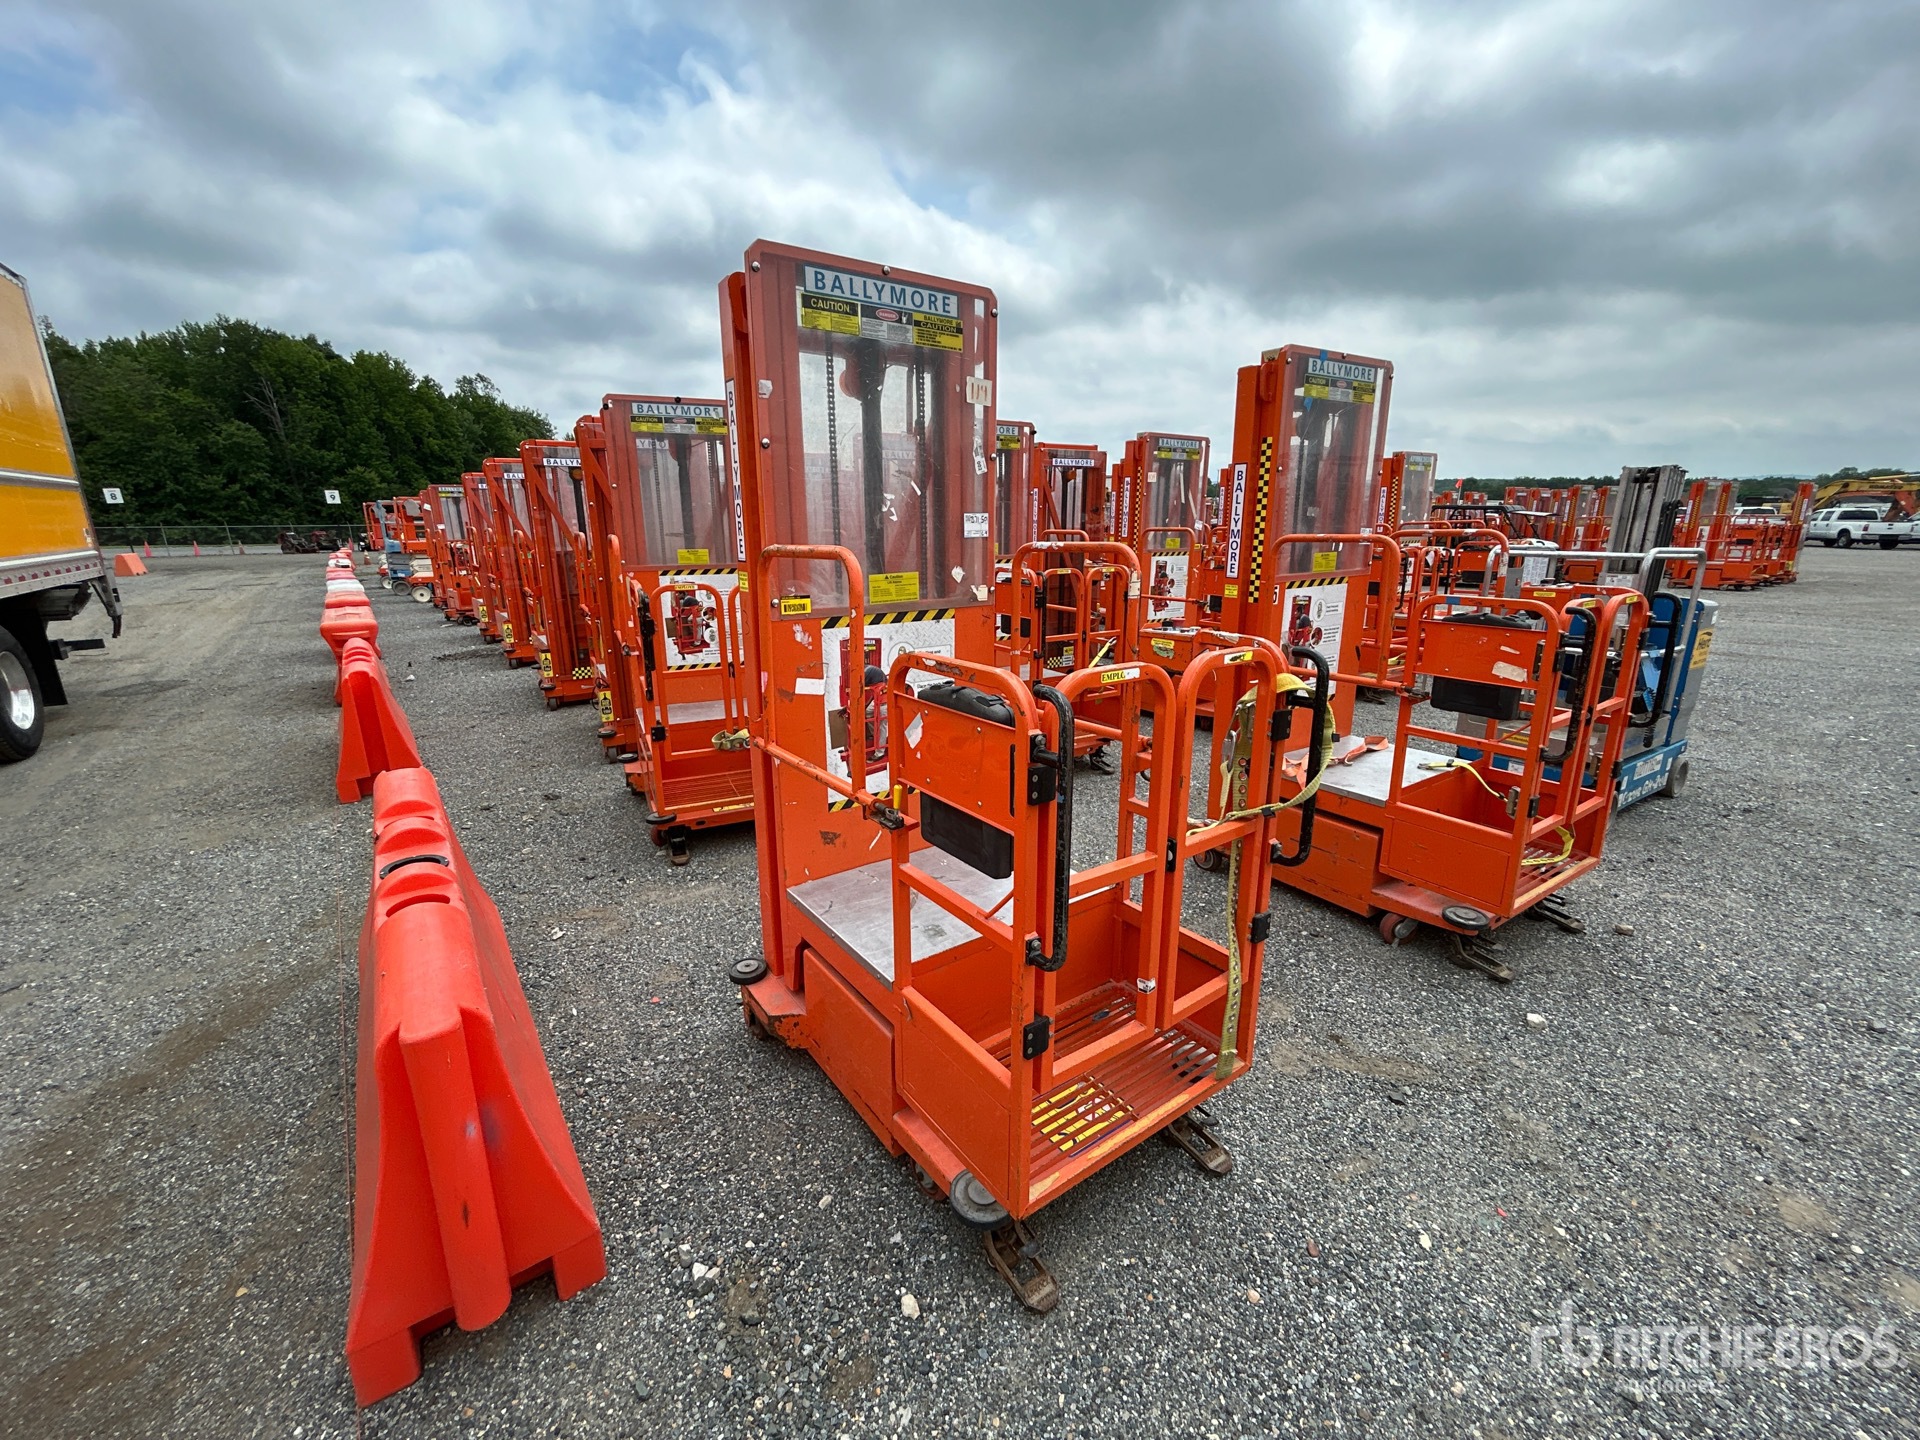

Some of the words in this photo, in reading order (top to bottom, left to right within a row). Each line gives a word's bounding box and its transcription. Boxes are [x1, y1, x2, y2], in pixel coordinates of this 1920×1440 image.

[813, 270, 952, 314] BALLYMORE
[810, 298, 850, 313] CAUTION
[920, 322, 957, 333] CAUTION
[1311, 360, 1372, 381] BALLYMORE
[996, 426, 1016, 435] ORE
[1160, 438, 1198, 448] BALLYMORE
[1054, 458, 1093, 466] BALLYMORE
[728, 391, 744, 554] BALLYMORE
[109, 492, 118, 501] 8
[1228, 470, 1244, 574] BALLYMORE
